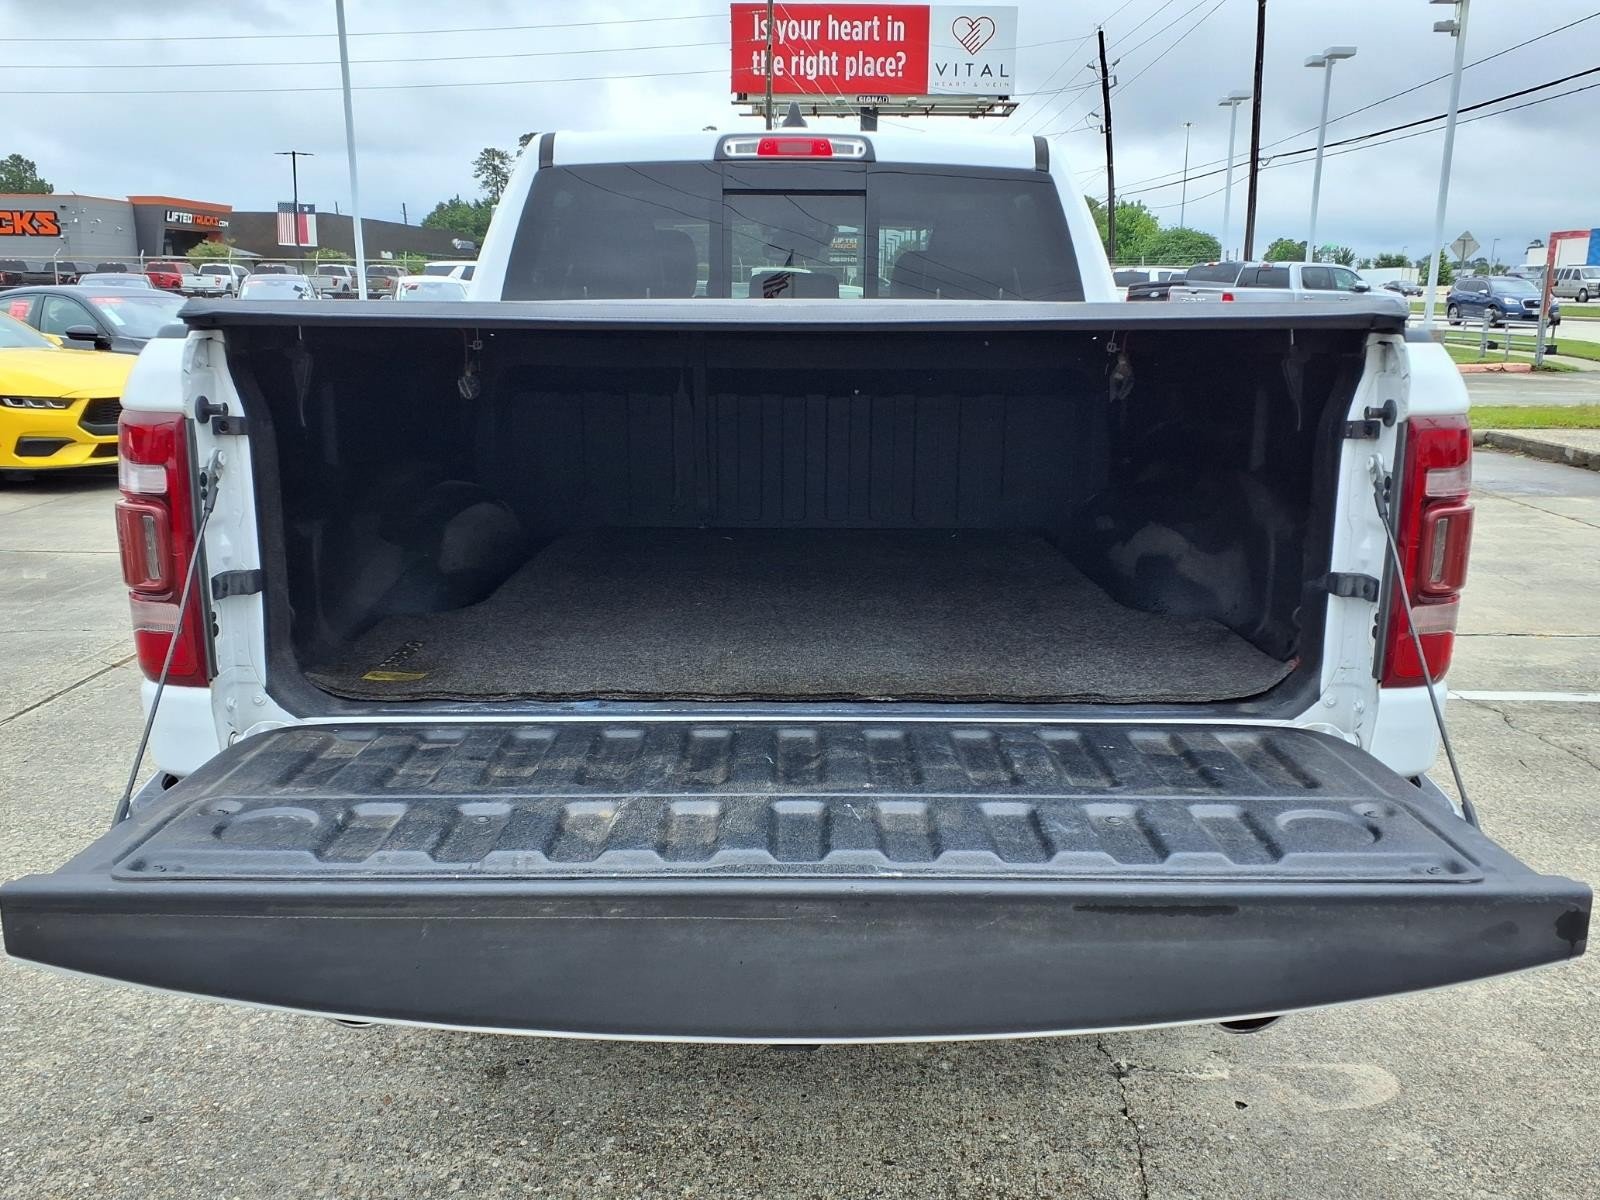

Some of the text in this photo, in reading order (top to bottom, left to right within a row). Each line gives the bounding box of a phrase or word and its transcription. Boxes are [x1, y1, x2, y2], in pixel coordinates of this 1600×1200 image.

[754, 14, 905, 45] Is your heart in
[791, 50, 838, 81] right
[846, 51, 906, 81] place?
[935, 62, 1010, 78] VITAL
